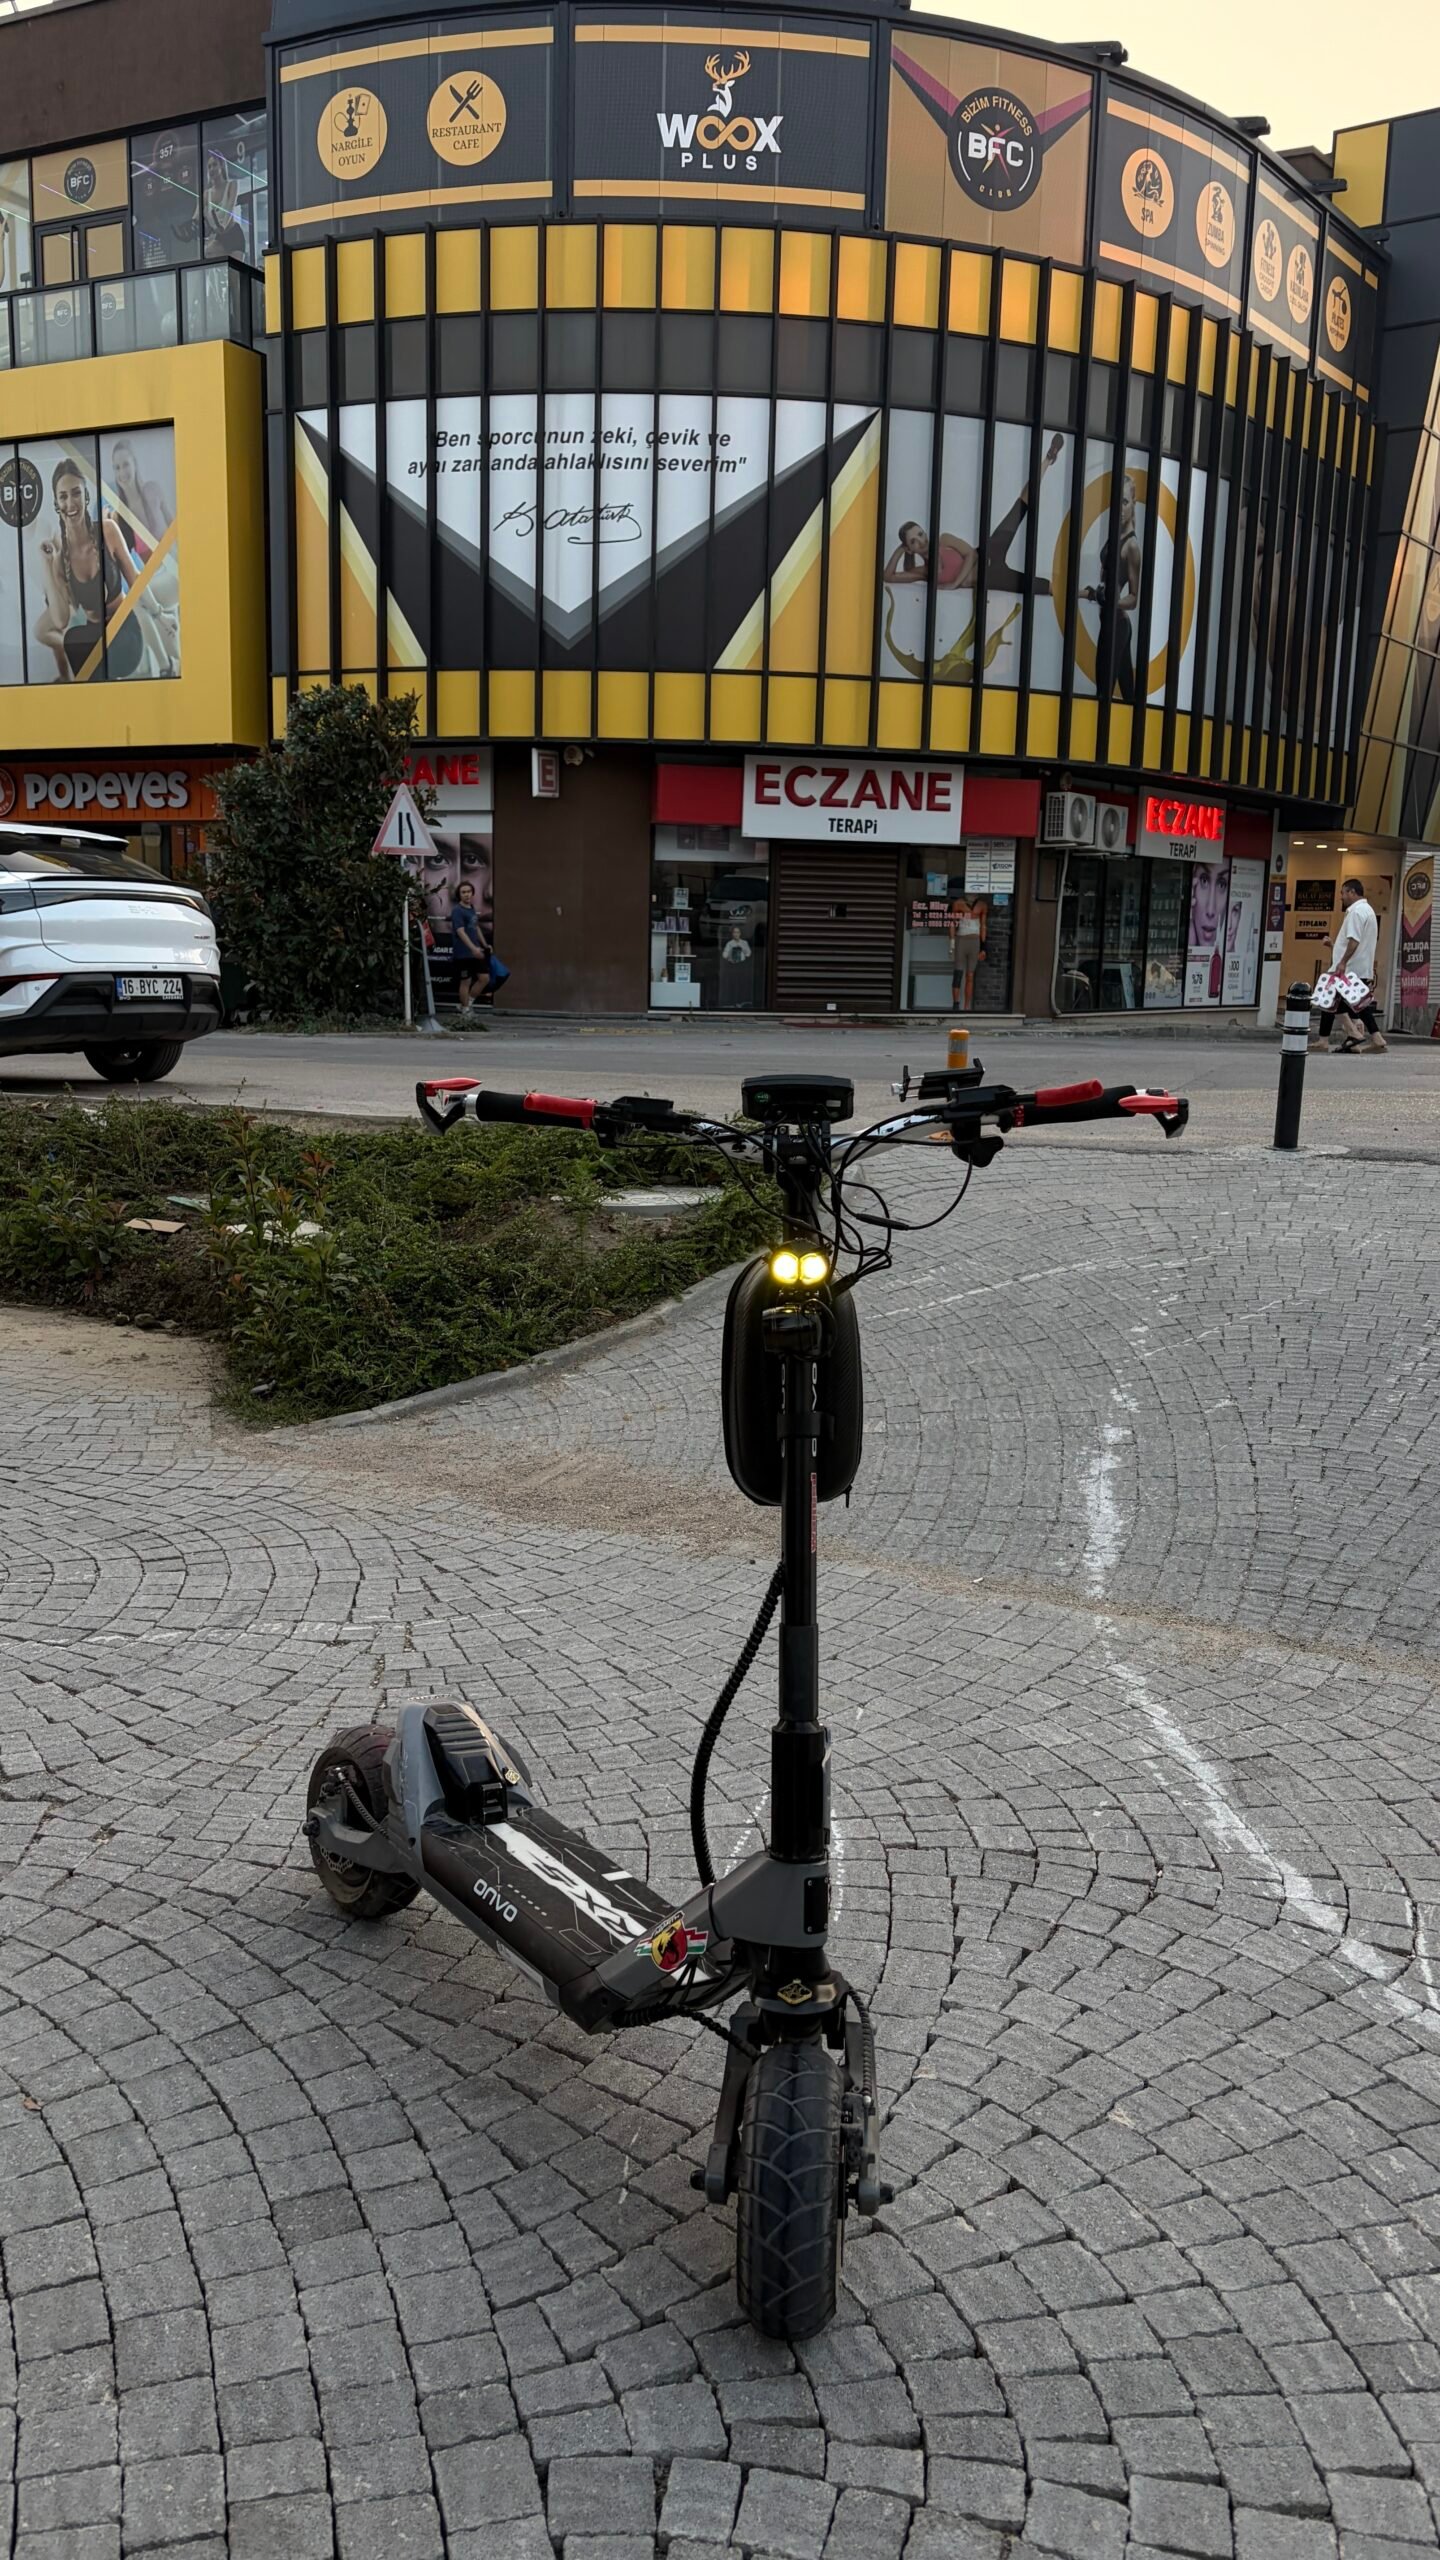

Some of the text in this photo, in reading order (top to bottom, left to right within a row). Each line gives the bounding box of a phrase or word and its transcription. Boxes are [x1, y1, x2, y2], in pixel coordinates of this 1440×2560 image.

[992, 95, 1033, 136] FITNESS
[432, 122, 502, 138] RESTAURANT
[331, 137, 373, 153] NARGİLE
[453, 138, 480, 150] CAFE
[968, 131, 1024, 167] BFC
[158, 145, 174, 160] 357
[338, 153, 366, 167] OYUN
[681, 152, 758, 171] PLUS
[70, 173, 91, 188] BFC
[979, 184, 1012, 198] CLUB
[1141, 207, 1154, 224] SPA
[645, 429, 700, 448] çevik
[708, 433, 731, 446] ve
[755, 764, 952, 812] ECZANE
[1146, 796, 1224, 841] ECZANE
[1169, 841, 1198, 859] TERAPİ
[123, 979, 181, 994] 16 BYC 224
